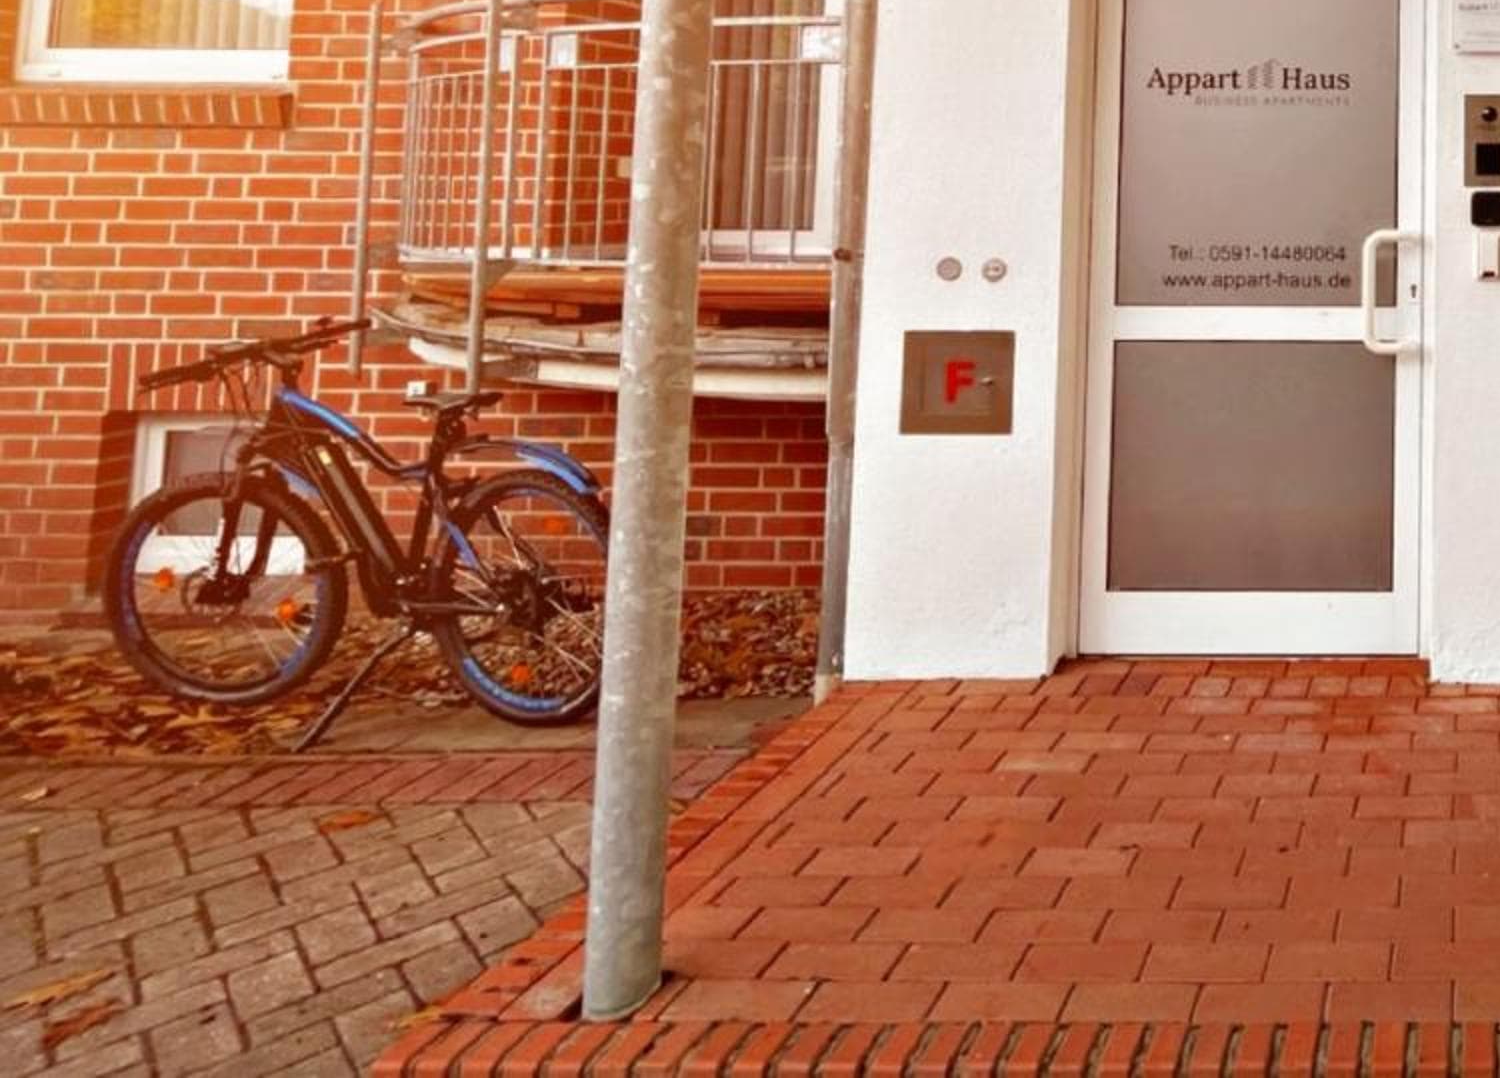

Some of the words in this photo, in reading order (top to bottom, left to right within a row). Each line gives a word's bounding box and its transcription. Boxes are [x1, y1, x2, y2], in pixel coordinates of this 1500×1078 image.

[1147, 66, 1241, 95] Appart
[1281, 67, 1351, 90] Haus
[1162, 272, 1351, 291] www.appart-haus.de
[946, 360, 976, 404] F
